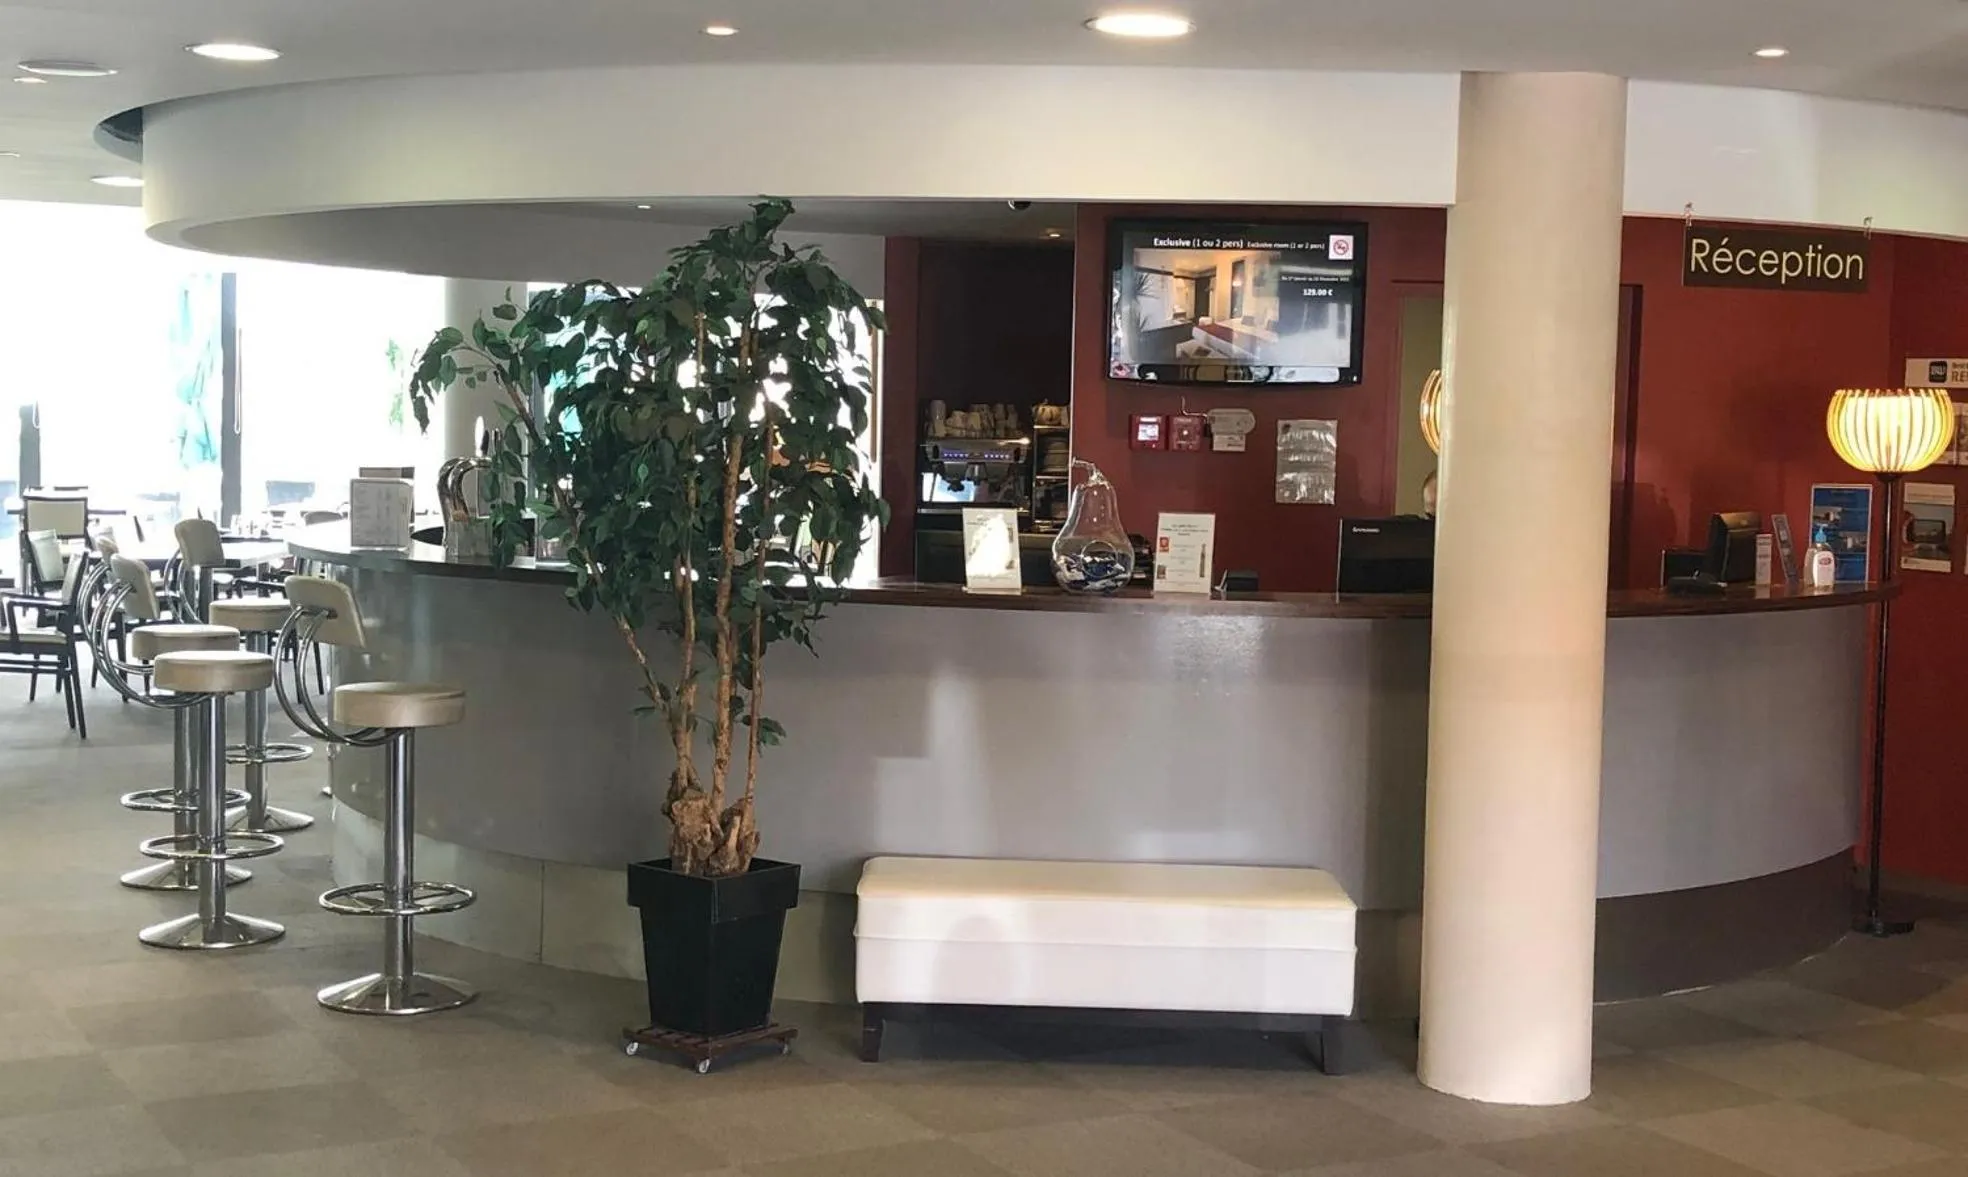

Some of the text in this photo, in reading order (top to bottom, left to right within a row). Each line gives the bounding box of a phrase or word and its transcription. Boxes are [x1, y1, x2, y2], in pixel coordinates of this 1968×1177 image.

[1153, 237, 1191, 247] Exclusive
[1215, 238, 1221, 247] 2
[1222, 239, 1244, 249] pers)
[1690, 237, 1863, 284] Réception
